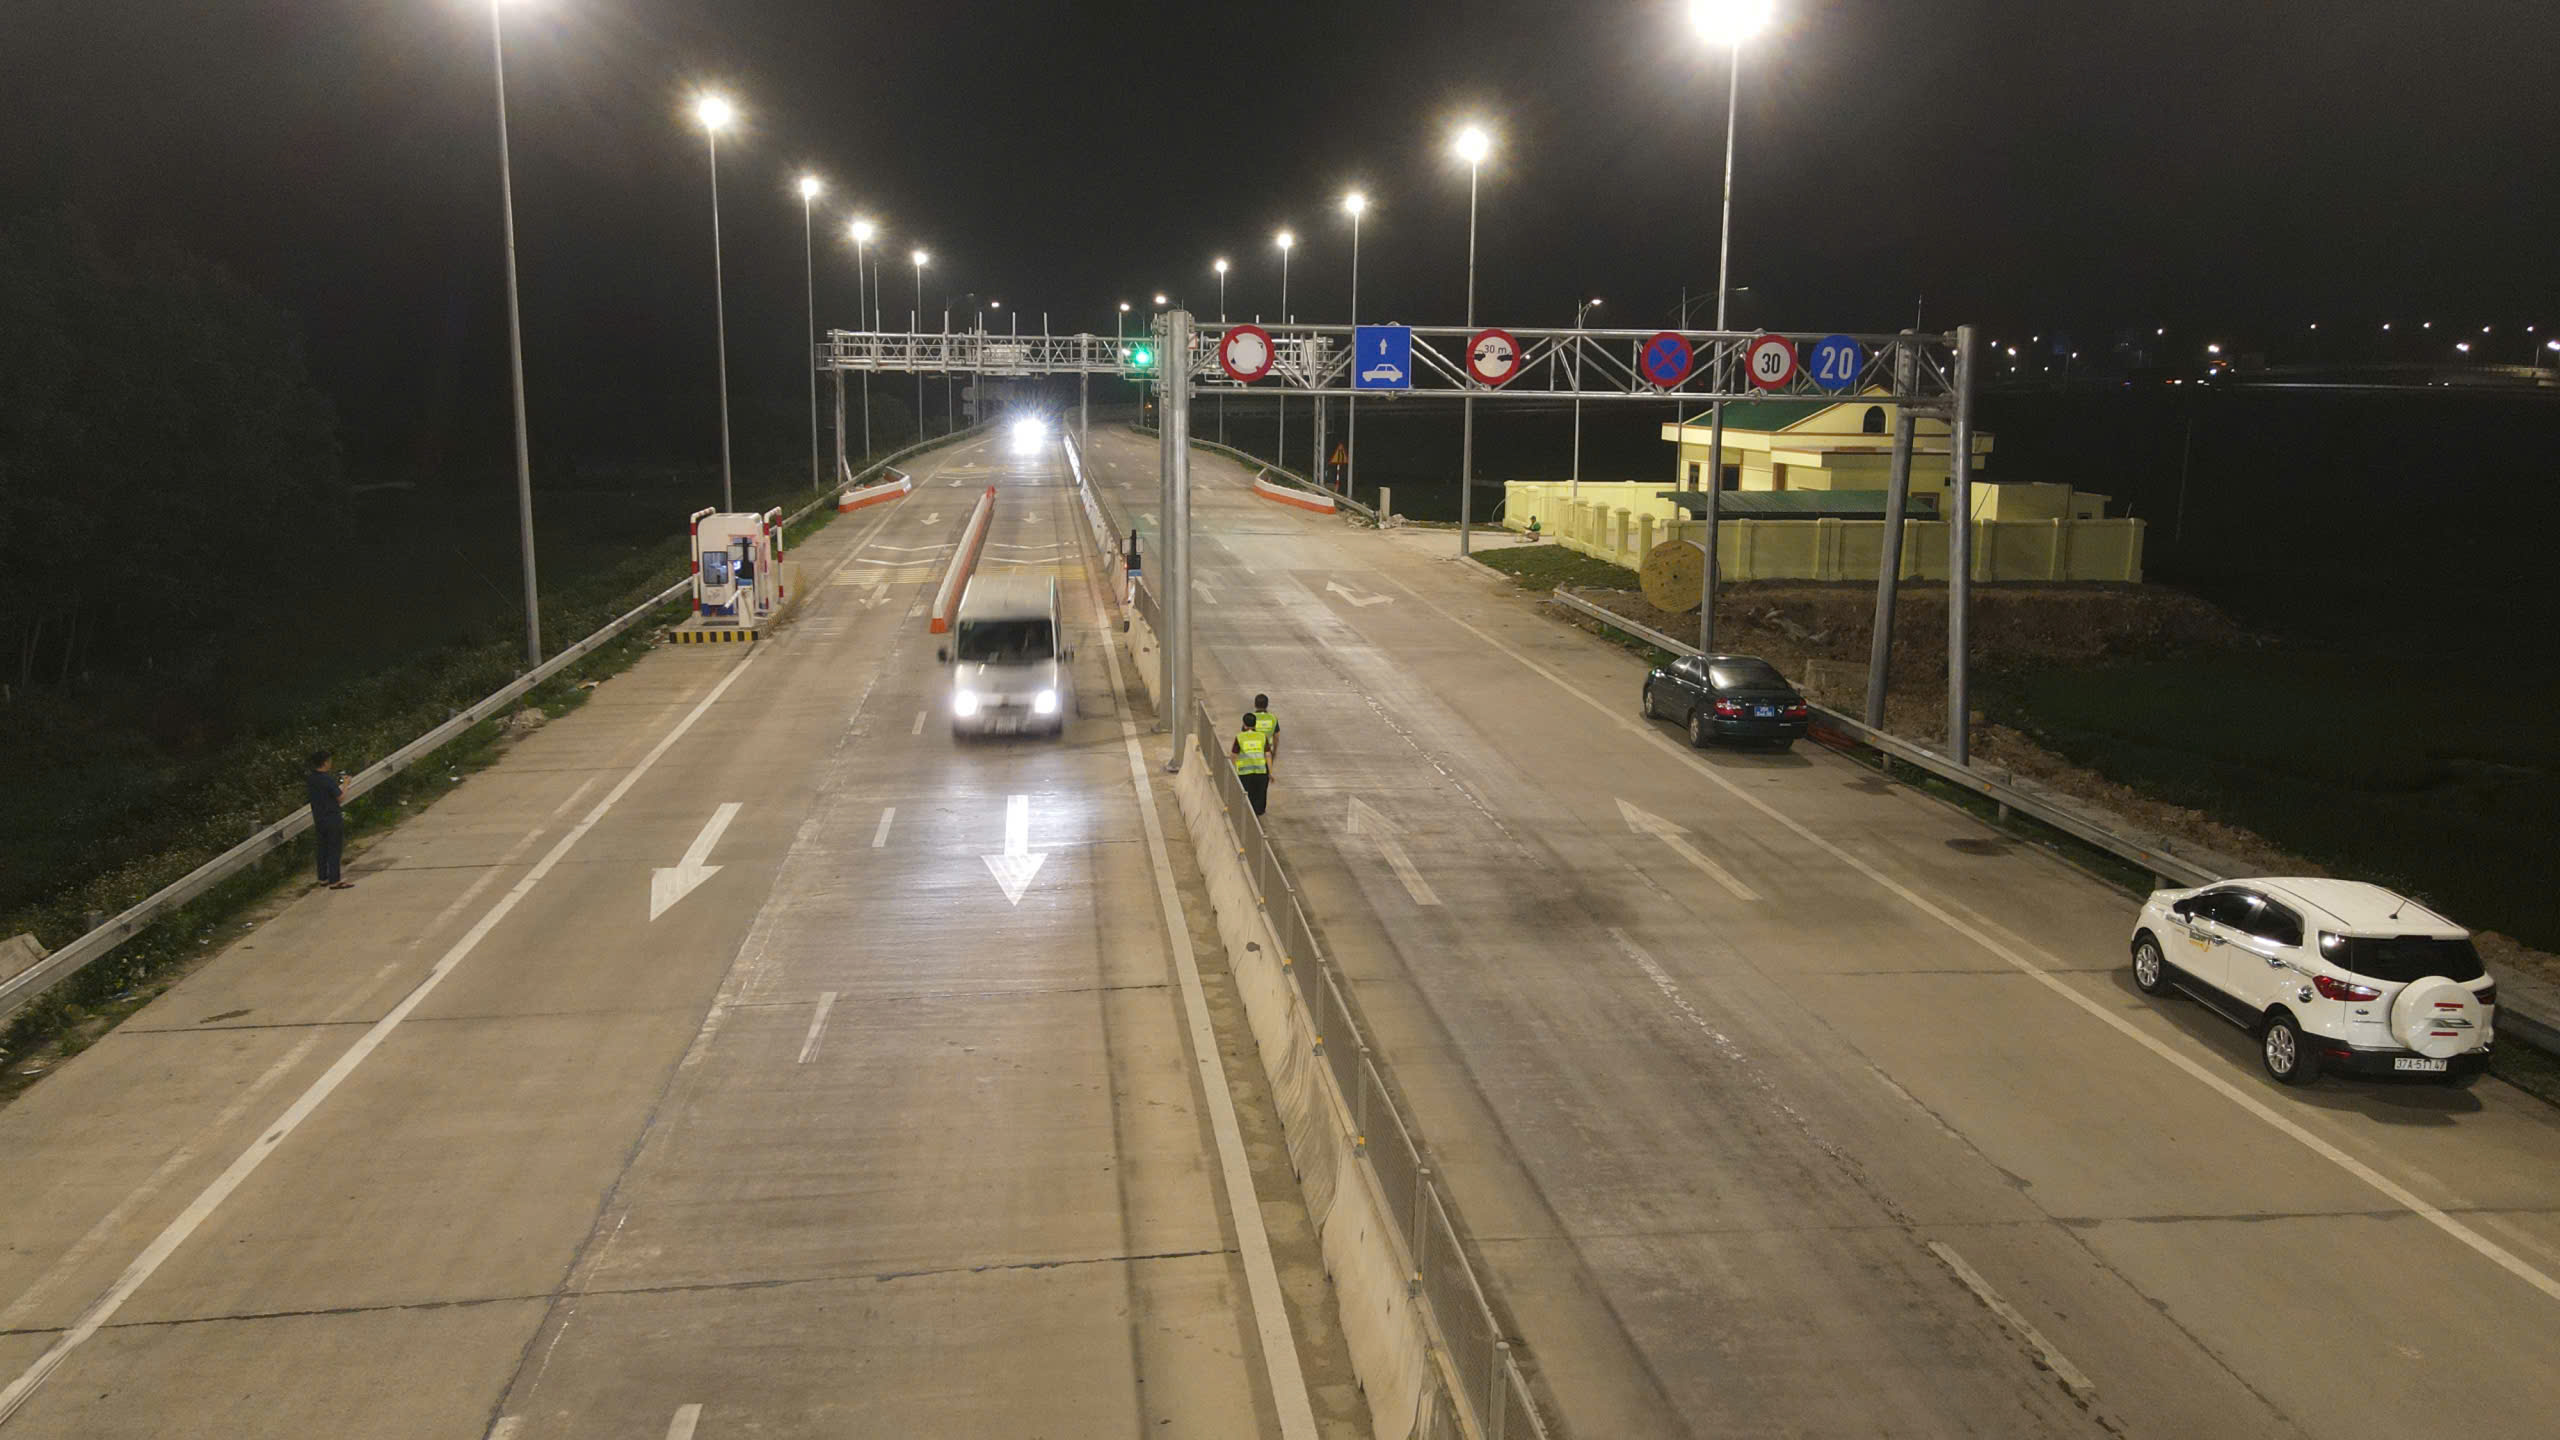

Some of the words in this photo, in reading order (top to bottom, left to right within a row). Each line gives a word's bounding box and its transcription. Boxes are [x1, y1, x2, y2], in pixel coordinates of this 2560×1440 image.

[1484, 344, 1496, 354] 30
[1497, 346, 1507, 354] m
[1761, 353, 1781, 374] 30
[1819, 346, 1854, 380] 20
